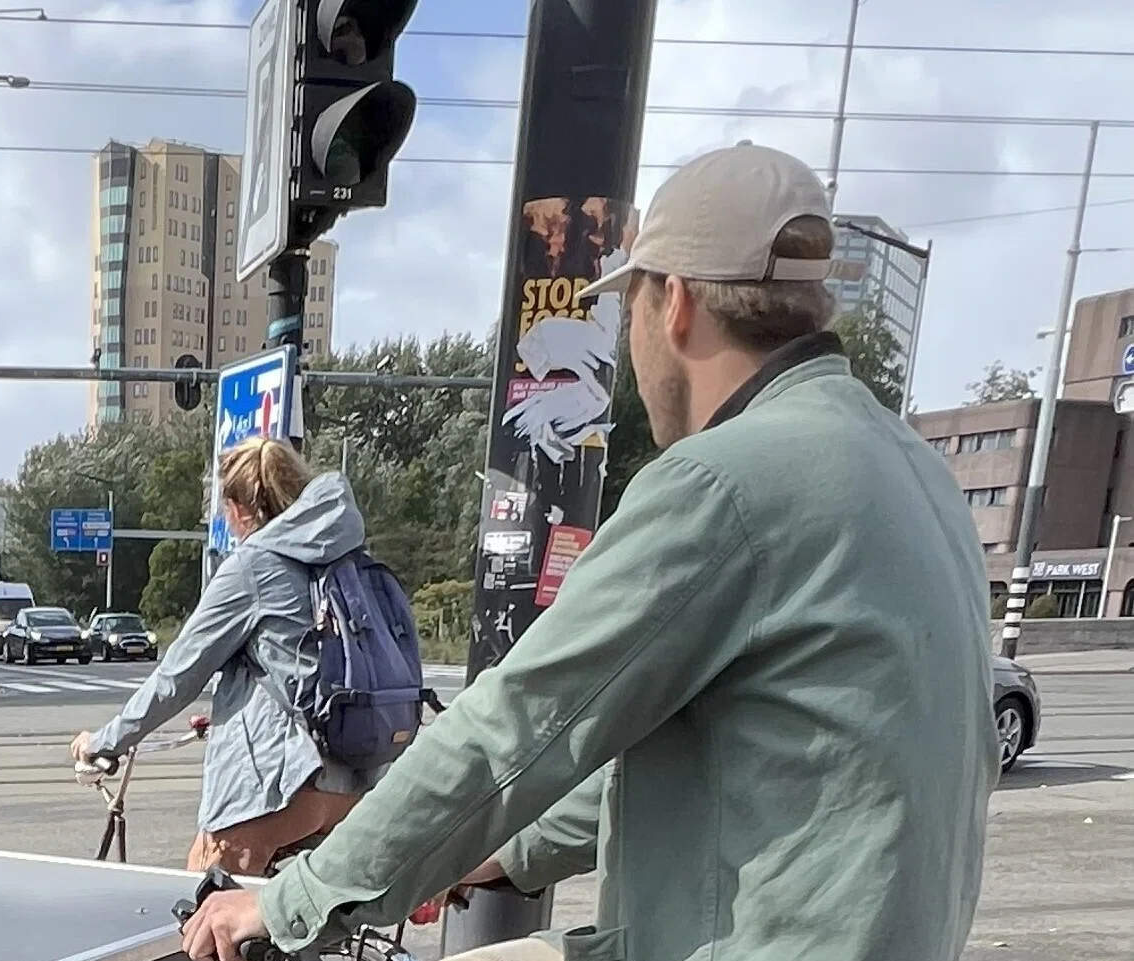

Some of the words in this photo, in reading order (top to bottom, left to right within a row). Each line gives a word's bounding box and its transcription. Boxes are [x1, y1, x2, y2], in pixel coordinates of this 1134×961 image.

[333, 187, 352, 199] 231
[522, 277, 590, 310] STOP
[1072, 563, 1100, 576] WEST
